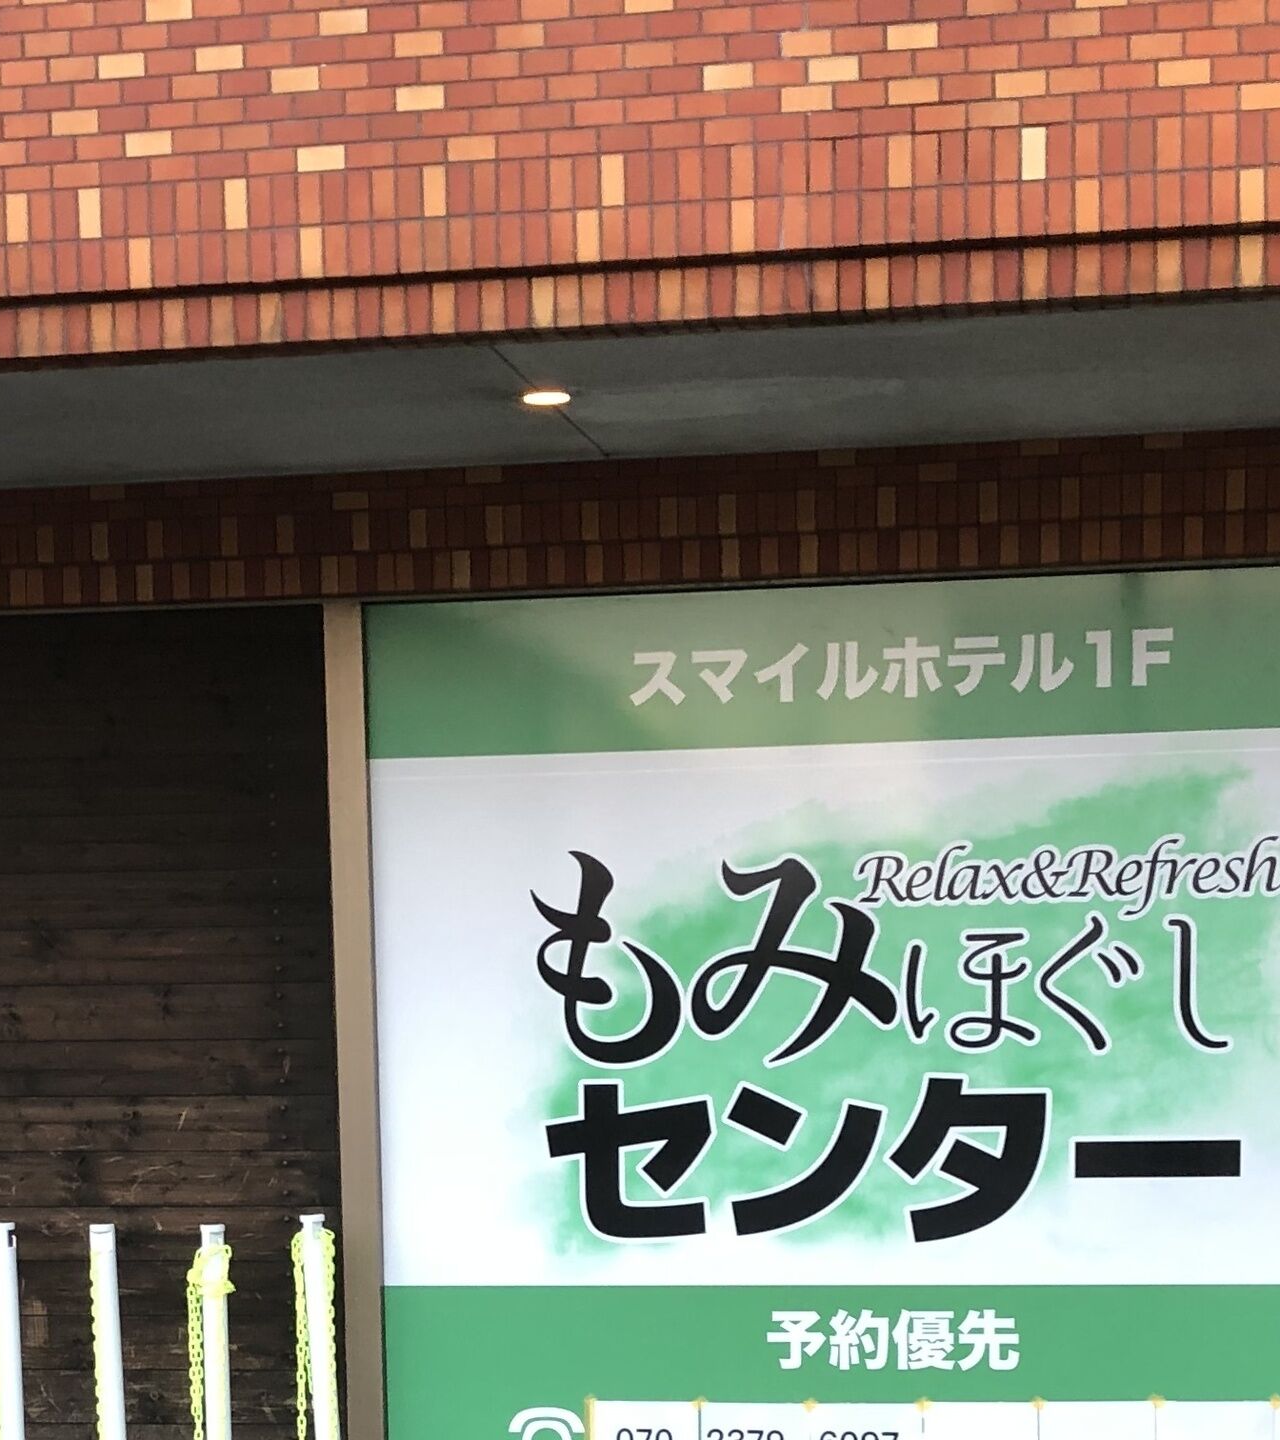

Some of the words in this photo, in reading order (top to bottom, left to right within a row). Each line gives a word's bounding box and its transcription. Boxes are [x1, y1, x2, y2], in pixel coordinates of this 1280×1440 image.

[628, 627, 1174, 706] スマイルホテル1F
[530, 850, 1230, 1066] もみほぐし
[545, 1077, 1242, 1243] センター
[767, 1309, 1020, 1371] 予約優先
